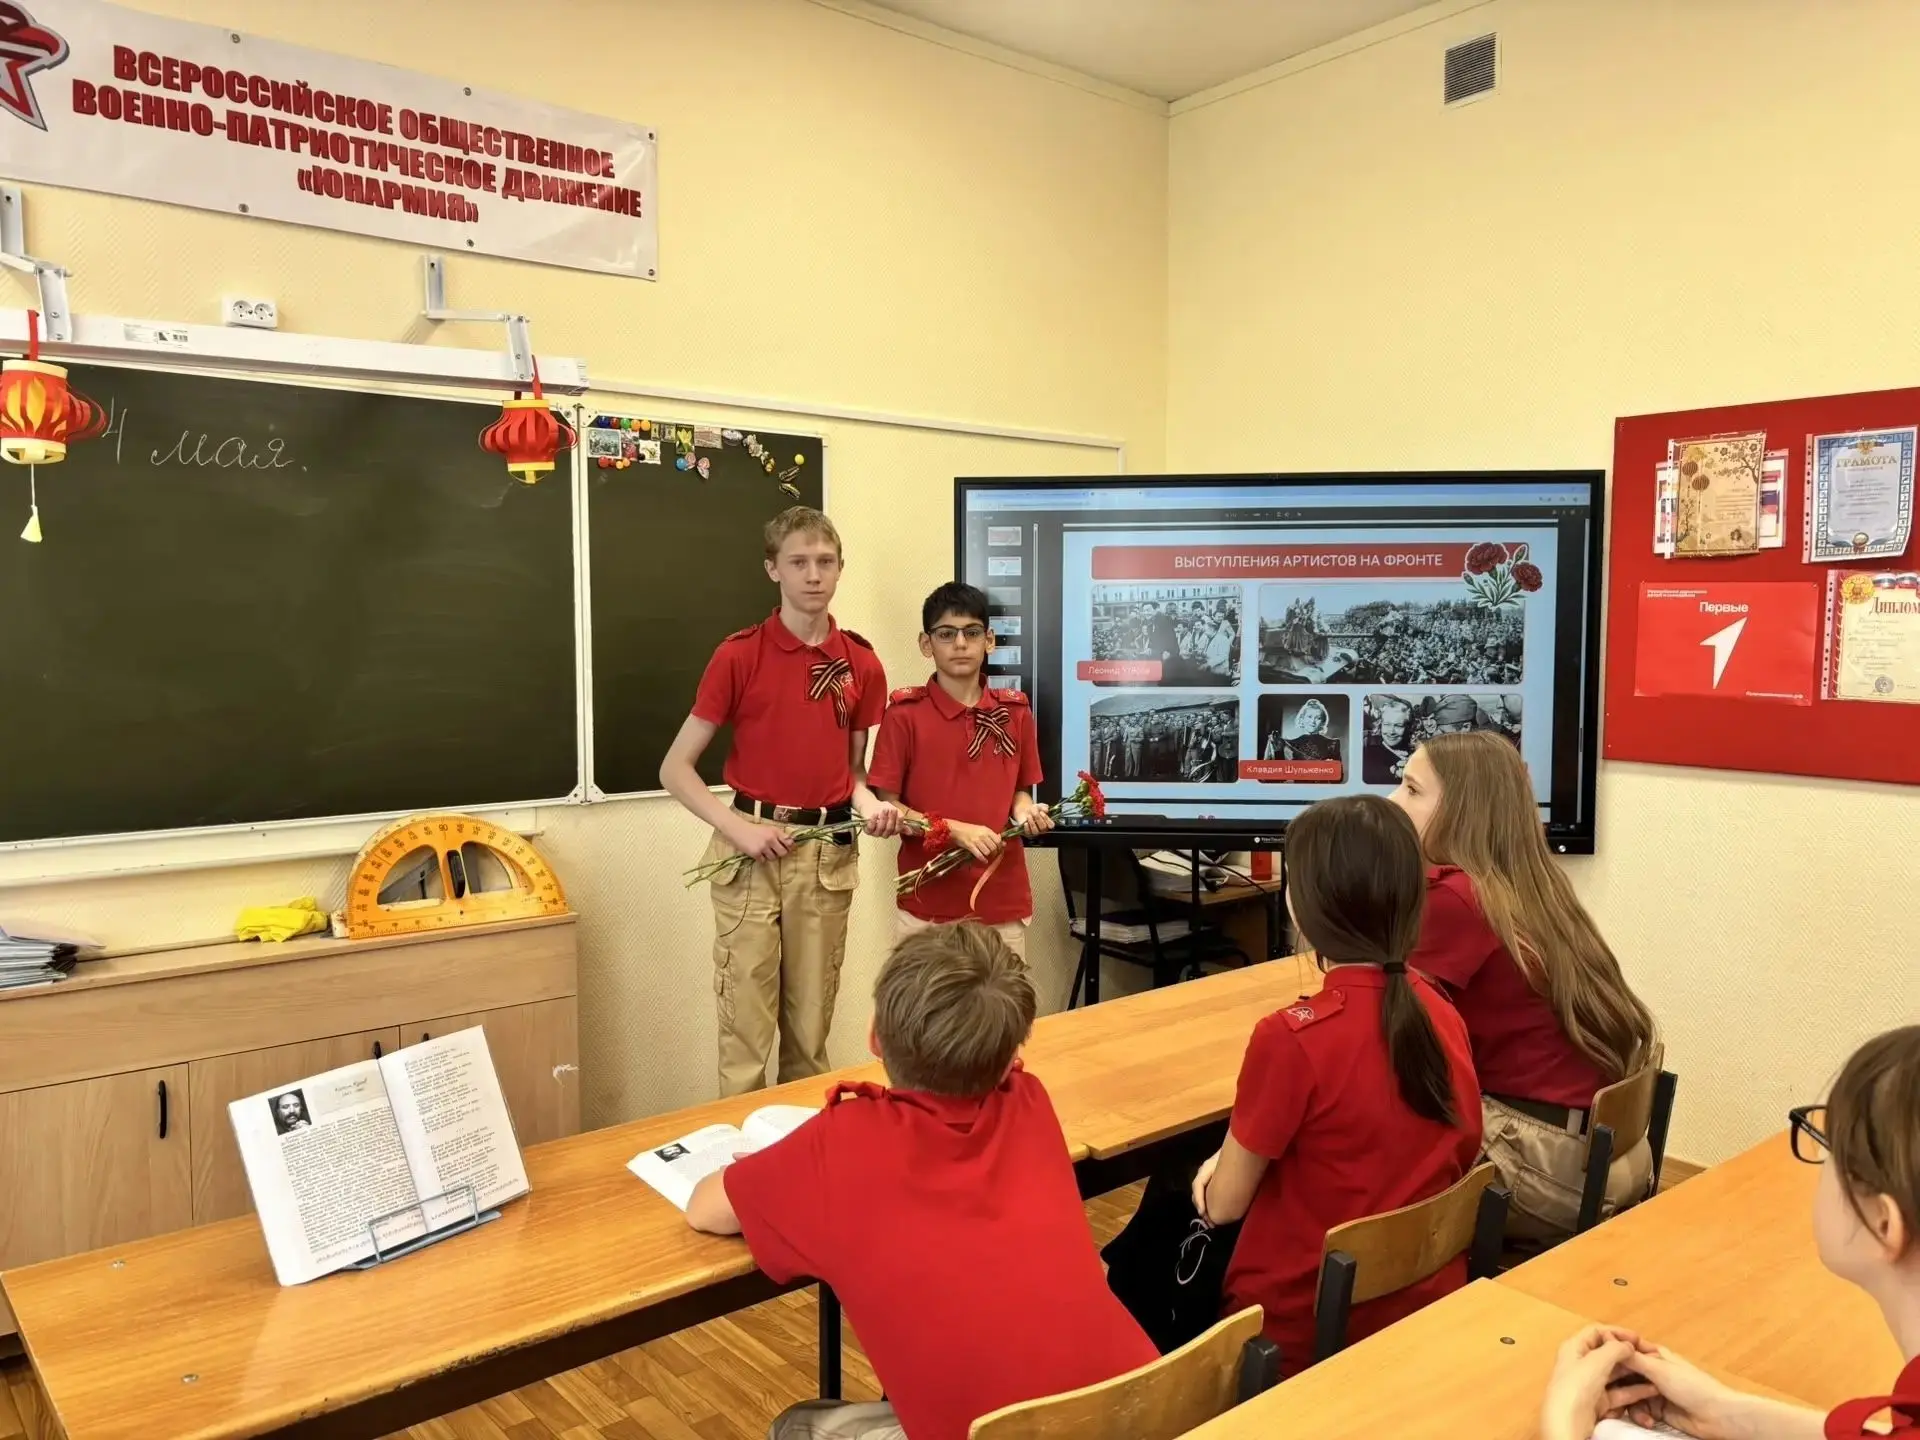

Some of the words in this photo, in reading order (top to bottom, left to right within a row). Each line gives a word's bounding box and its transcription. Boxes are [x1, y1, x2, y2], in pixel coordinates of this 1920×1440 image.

[113, 44, 393, 136] ВСЕРОССИЙСКОЕ
[399, 108, 615, 179] ОБЩЕСТВЕННОЕ
[72, 78, 497, 193] ВОЕННО-ПАТРИОТИЧЕСКОЕ
[501, 166, 642, 218] ДВИЖЕНИЕ
[297, 165, 479, 223] «ЮНАРМИЯ»
[1836, 455, 1898, 468] ГРАМОТА
[1174, 555, 1279, 568] ВЫСТУПЛЕНИЯ
[1283, 555, 1357, 568] АРТИСТОВ
[1360, 555, 1380, 567] НА
[1384, 554, 1443, 567] ФРОНТЕ
[1699, 601, 1749, 615] Первые
[1246, 765, 1283, 775] Клавдия
[1285, 765, 1334, 775] Шульженко
